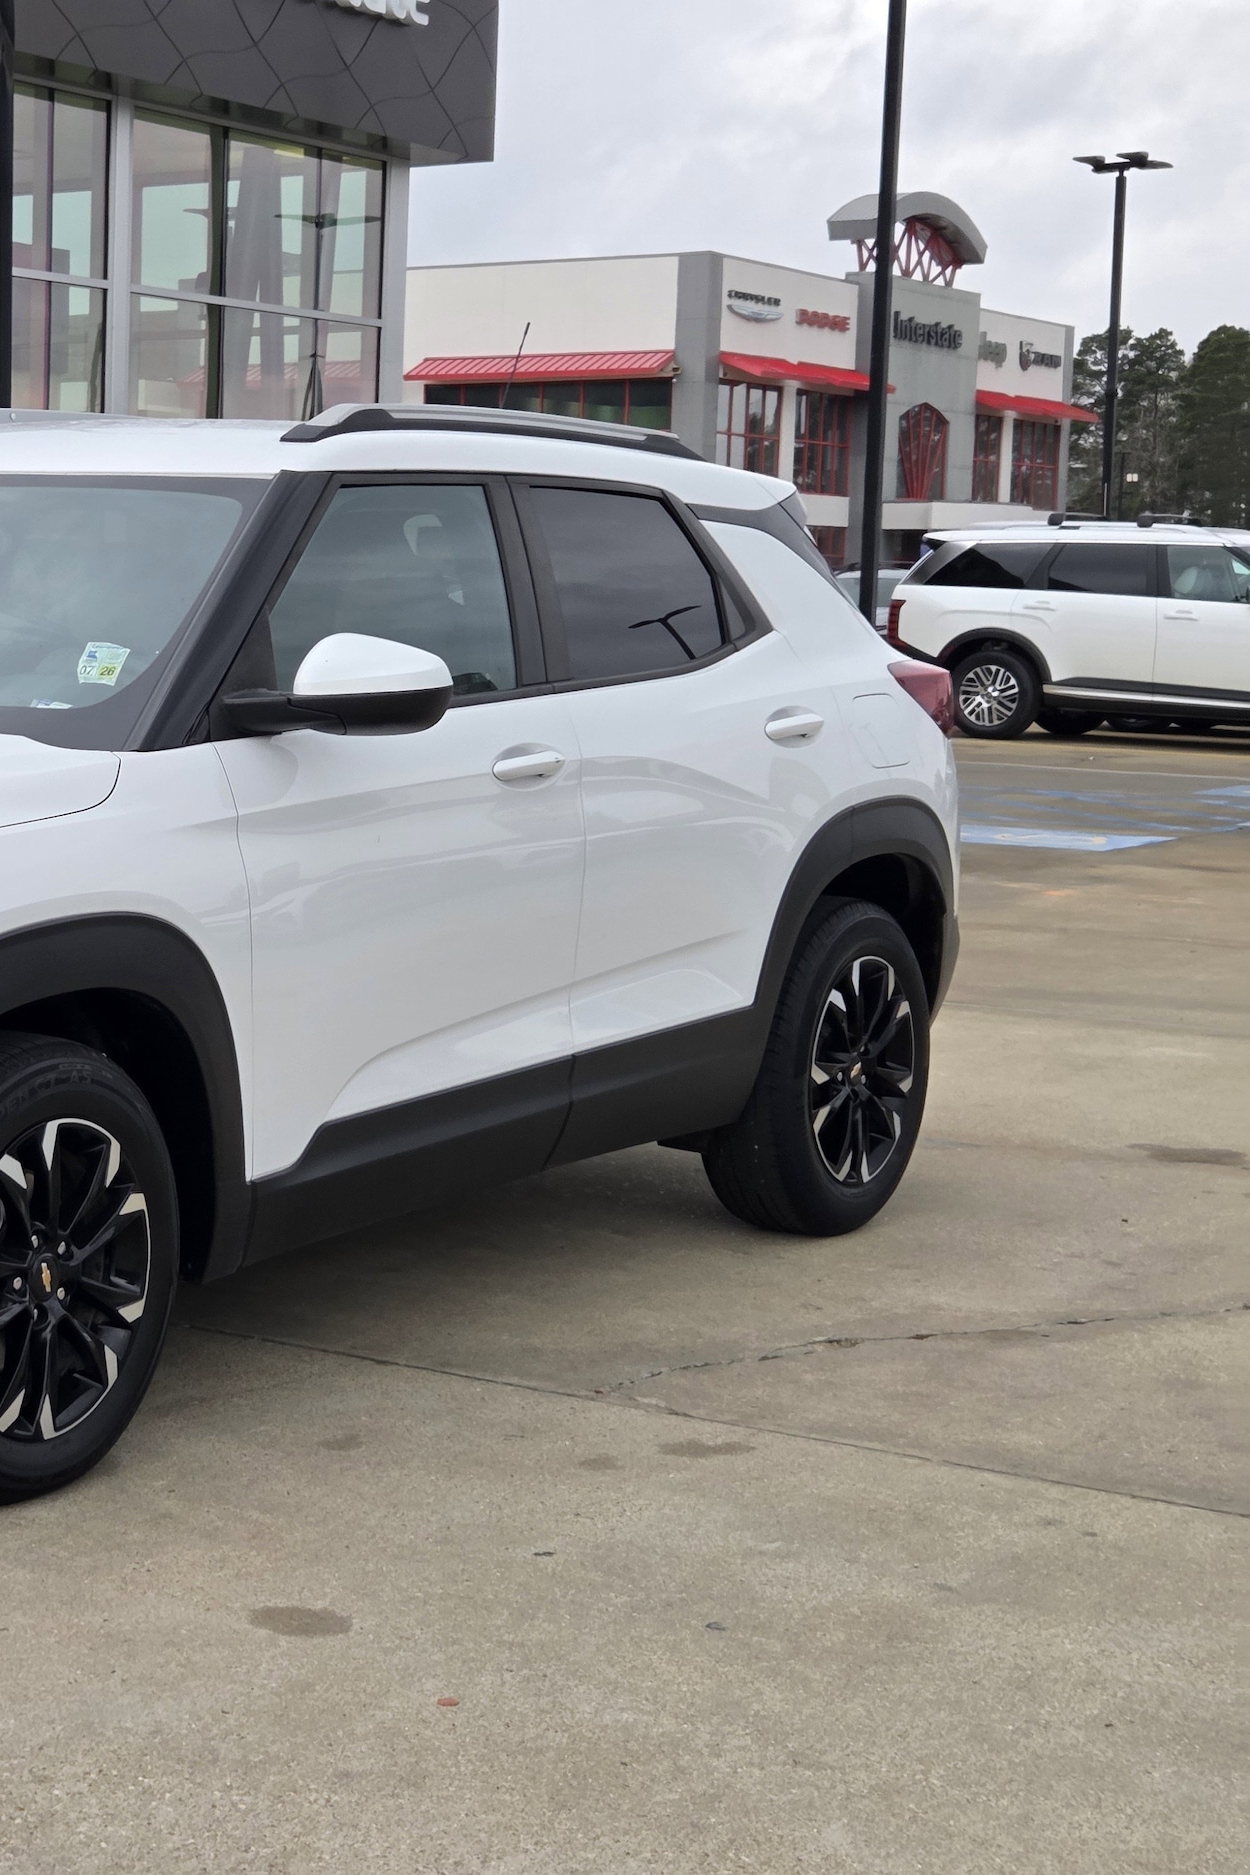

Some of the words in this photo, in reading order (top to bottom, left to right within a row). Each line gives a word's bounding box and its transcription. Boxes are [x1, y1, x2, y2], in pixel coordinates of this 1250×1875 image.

[795, 308, 851, 333] DODGE
[893, 310, 963, 350] Interstate
[80, 665, 95, 675] 07
